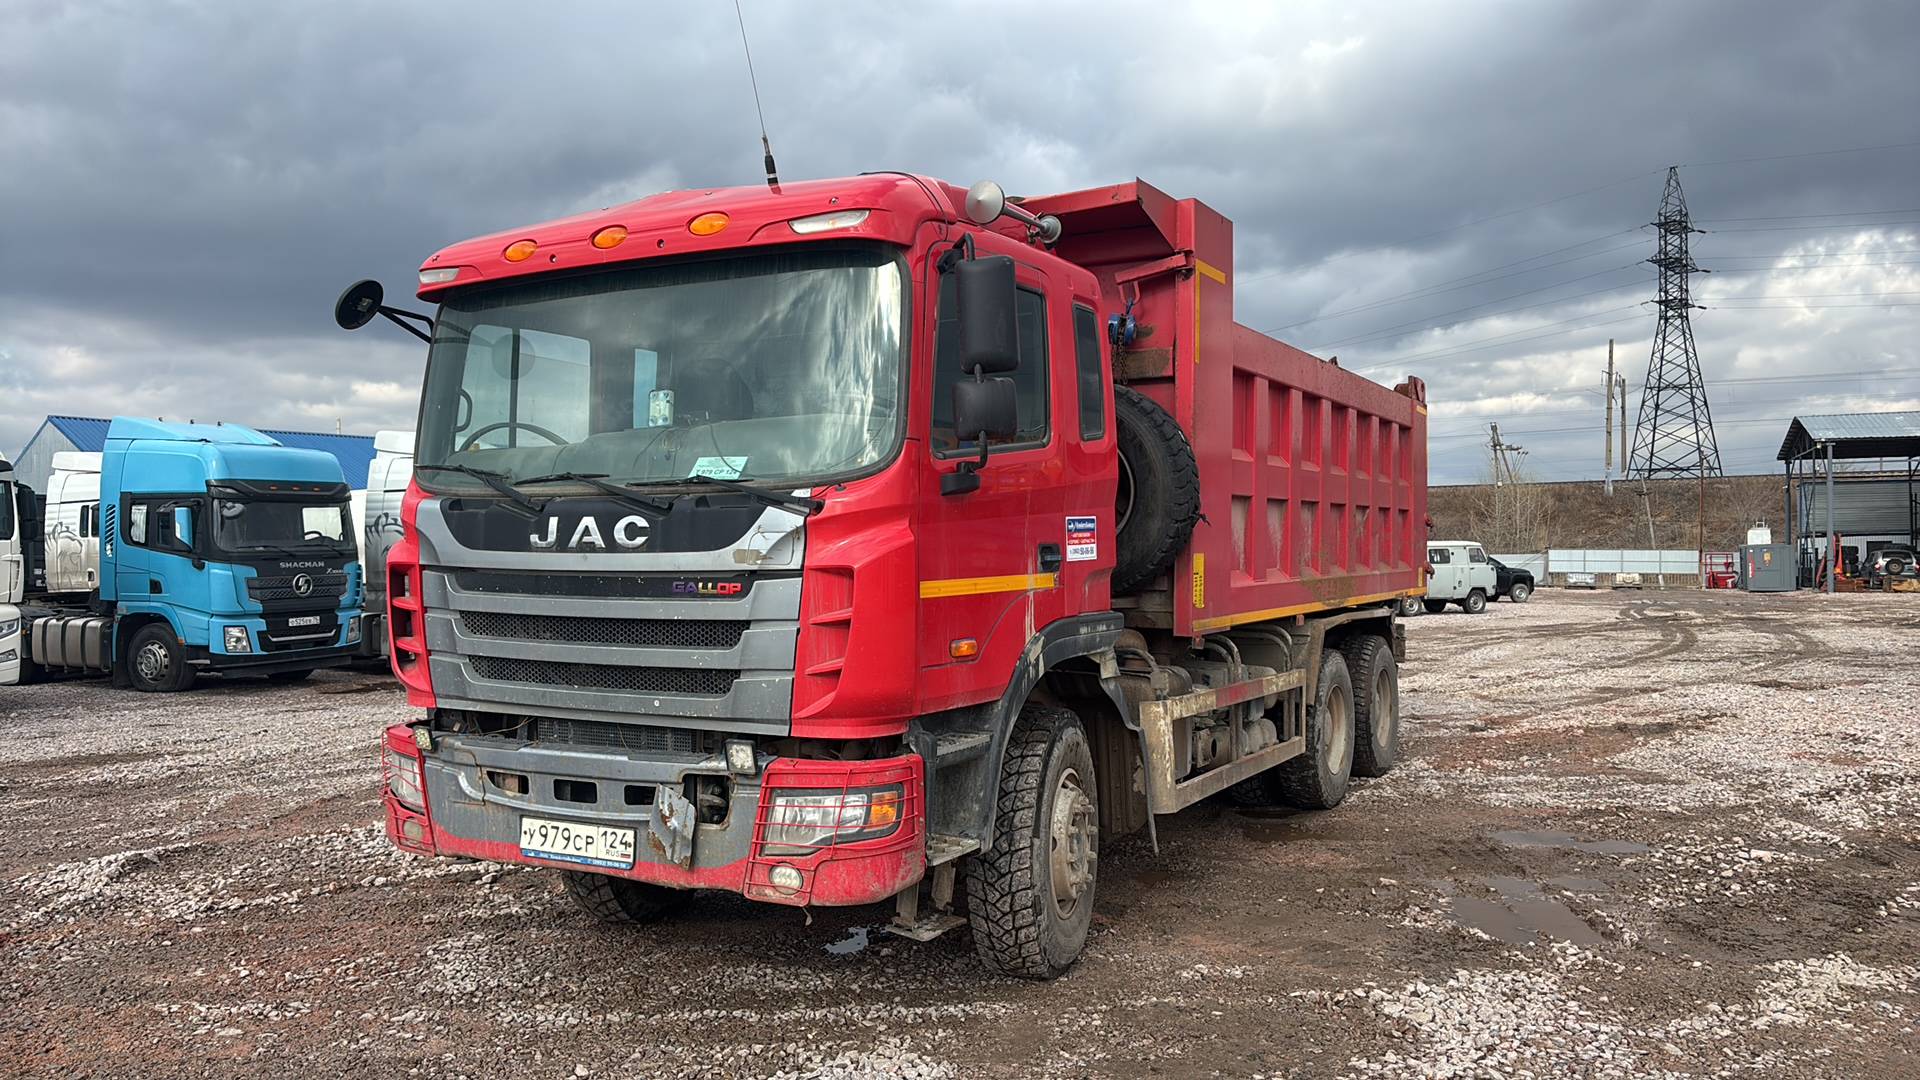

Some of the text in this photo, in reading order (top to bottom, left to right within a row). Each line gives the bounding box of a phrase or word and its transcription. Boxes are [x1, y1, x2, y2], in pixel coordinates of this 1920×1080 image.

[529, 515, 650, 548] JAC
[672, 581, 742, 594] GALLOP
[601, 830, 628, 850] 124
[605, 849, 620, 857] RUS
